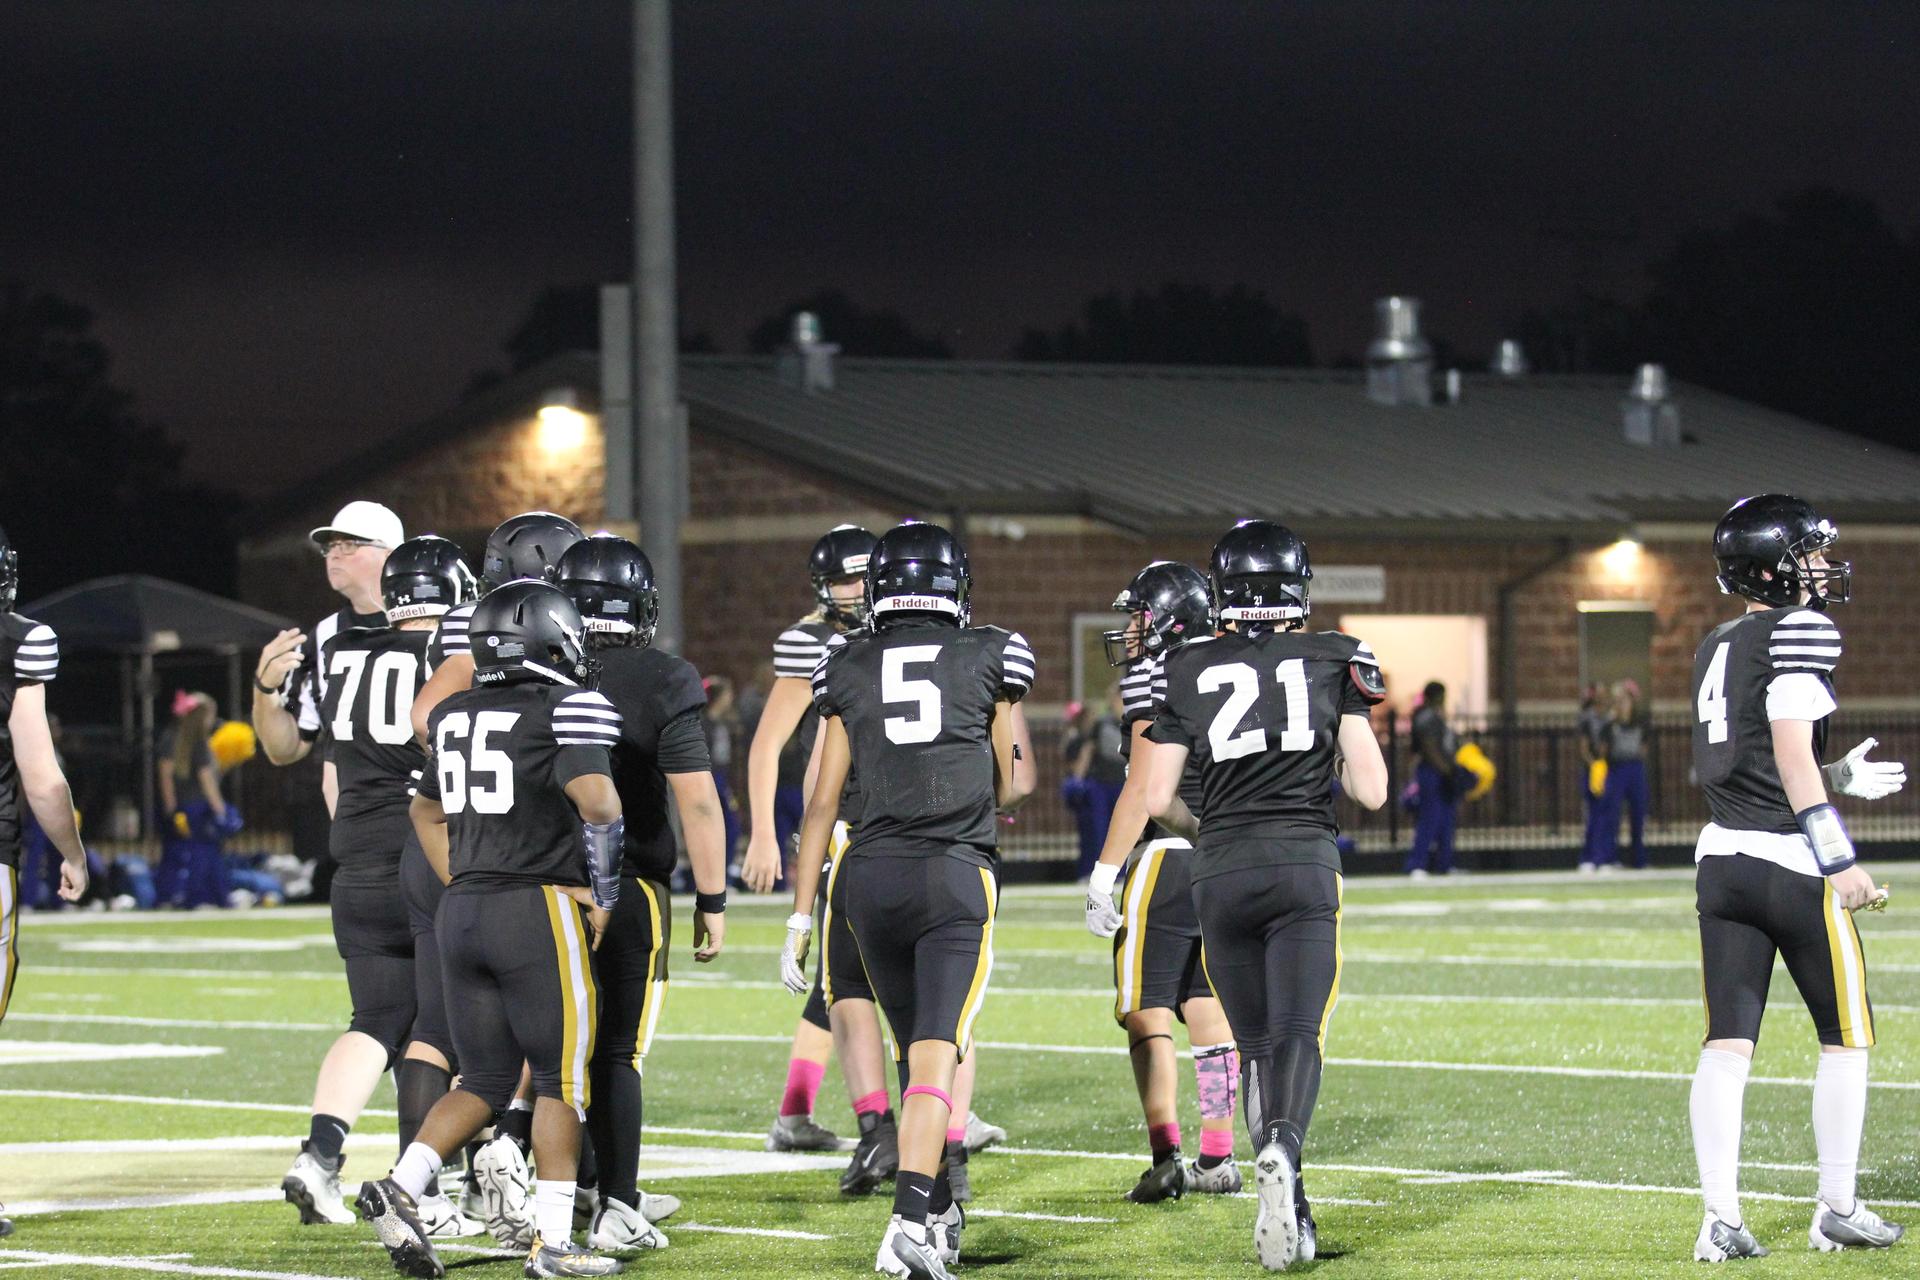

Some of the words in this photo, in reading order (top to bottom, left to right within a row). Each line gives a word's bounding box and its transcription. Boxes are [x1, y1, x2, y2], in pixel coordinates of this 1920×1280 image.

[390, 606, 426, 620] Riddell
[892, 598, 938, 609] Riddell
[1241, 610, 1286, 619] Riddell
[1253, 595, 1263, 606] 21
[329, 650, 418, 745] 70
[881, 645, 943, 745] 5
[1197, 658, 1315, 763] 21
[1697, 642, 1731, 744] 4
[437, 710, 521, 814] 65
